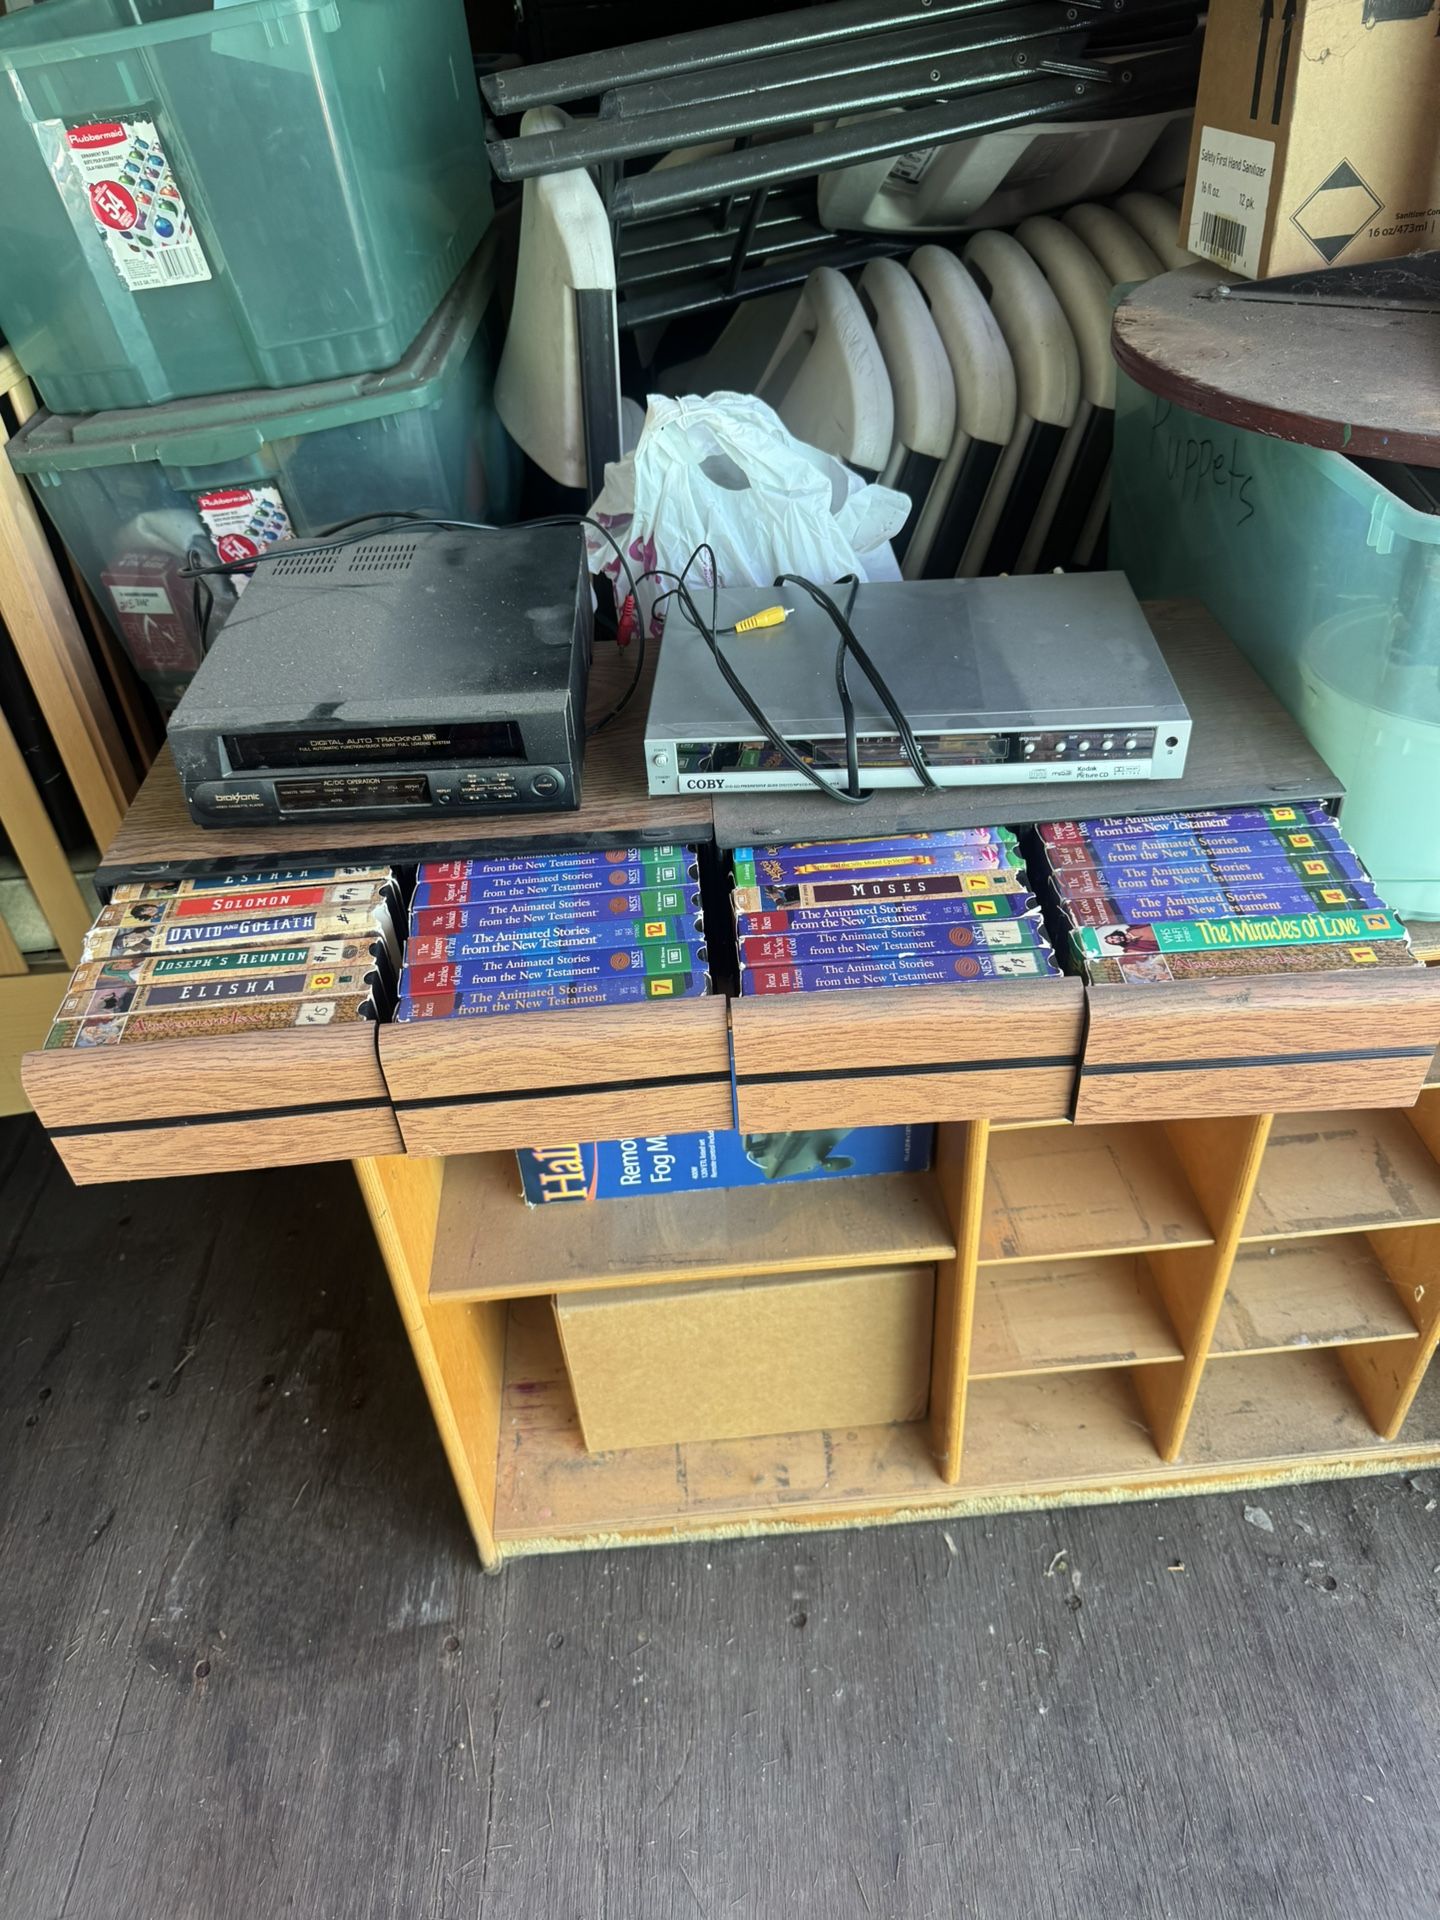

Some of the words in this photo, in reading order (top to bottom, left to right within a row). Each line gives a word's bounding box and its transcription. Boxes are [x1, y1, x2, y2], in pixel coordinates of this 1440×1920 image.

[69, 127, 123, 144] Rubbermaid
[1201, 149, 1215, 167] Safety
[1216, 152, 1228, 168] First
[1228, 156, 1242, 171] Hand
[1242, 160, 1267, 177] Sanitizer
[98, 189, 127, 220] 54
[1239, 193, 1245, 206] 12
[1369, 228, 1380, 237] 16
[1382, 221, 1428, 236] oz/473ml
[201, 492, 252, 507] Rubbermaid
[346, 737, 373, 745] AUTO
[375, 735, 422, 743] TRACKING
[422, 733, 437, 741] VHS
[687, 779, 725, 789] COBY
[1274, 808, 1292, 816] 9
[1095, 827, 1123, 837] from
[1125, 825, 1143, 835] the
[1144, 823, 1169, 833] New
[1170, 818, 1228, 831] Testament
[1113, 843, 1136, 852] The
[1141, 838, 1196, 850] Animated
[1198, 836, 1238, 847] Stories
[1292, 836, 1309, 844] 6
[1107, 853, 1137, 862] from
[1140, 850, 1159, 860] the
[1162, 849, 1189, 858] New
[1191, 845, 1252, 857] Testament
[1122, 868, 1147, 878] The
[1151, 863, 1208, 876] Animated
[1210, 862, 1251, 872] Stories
[1306, 863, 1325, 871] 5
[628, 869, 637, 885] NEST
[969, 879, 986, 887] 7
[1068, 877, 1080, 888] The
[1117, 879, 1148, 889] from
[1150, 877, 1170, 887] the
[1172, 875, 1200, 885] New
[1204, 871, 1265, 884] Testament
[852, 881, 926, 897] MOSES
[1326, 891, 1342, 900] 4
[211, 895, 291, 911] SOLOMON
[629, 895, 638, 912] NEST
[1136, 898, 1161, 908] The
[1166, 892, 1224, 906] Animated
[1227, 891, 1268, 902] Stories
[799, 910, 821, 920] The
[823, 906, 878, 918] Animated
[879, 903, 918, 914] Stories
[976, 904, 993, 912] 7
[1130, 909, 1162, 919] from
[1165, 907, 1185, 917] the
[1187, 904, 1216, 915] New
[1221, 900, 1282, 913] Testament
[168, 925, 223, 942] DAVID
[223, 923, 238, 931] AND
[239, 916, 313, 934] GOLIATH
[791, 920, 819, 930] from
[821, 918, 839, 928] the
[841, 916, 867, 927] New
[867, 912, 927, 924] Testament
[1195, 918, 1232, 945] The
[1229, 915, 1301, 942] Miracles
[1301, 912, 1320, 938] of
[1318, 914, 1360, 937] Love
[1367, 916, 1386, 926] 2
[472, 934, 494, 944] The
[495, 928, 551, 942] Animated
[553, 926, 590, 938] Stories
[647, 924, 663, 936] 12
[817, 934, 837, 943] The
[840, 930, 888, 941] Animated
[891, 927, 925, 937] Stories
[972, 925, 987, 946] NEST
[1161, 929, 1170, 944] VHS
[314, 945, 339, 962] #17
[418, 943, 430, 956] The
[461, 945, 490, 956] from
[492, 943, 510, 953] the
[512, 941, 538, 951] New
[540, 936, 597, 949] Testament
[810, 946, 835, 955] from
[837, 944, 854, 953] the
[856, 942, 880, 952] New
[882, 940, 934, 950] Testament
[155, 956, 228, 971] JOSEPH'S
[237, 951, 307, 965] REUNION
[630, 950, 640, 969] NEST
[1354, 951, 1371, 959] 1
[823, 965, 844, 974] The
[847, 961, 896, 973] Animated
[899, 958, 934, 969] Stories
[978, 955, 994, 976] NEST
[315, 976, 331, 985] 8
[423, 972, 435, 983] The
[436, 965, 449, 987] Parables
[815, 977, 841, 987] from
[844, 975, 861, 984] the
[863, 974, 887, 984] New
[889, 971, 944, 982] Testament
[179, 980, 275, 999] ELISHA
[470, 993, 493, 1004] The
[495, 986, 554, 1001] Animated
[558, 983, 598, 995] Stories
[653, 983, 671, 992] 7
[458, 1005, 487, 1016] from
[492, 1002, 511, 1012] the
[515, 999, 543, 1010] New
[547, 993, 607, 1007] Testament
[305, 1005, 328, 1022] #15
[619, 1136, 642, 1186] Remo
[650, 1154, 676, 1184] Fog
